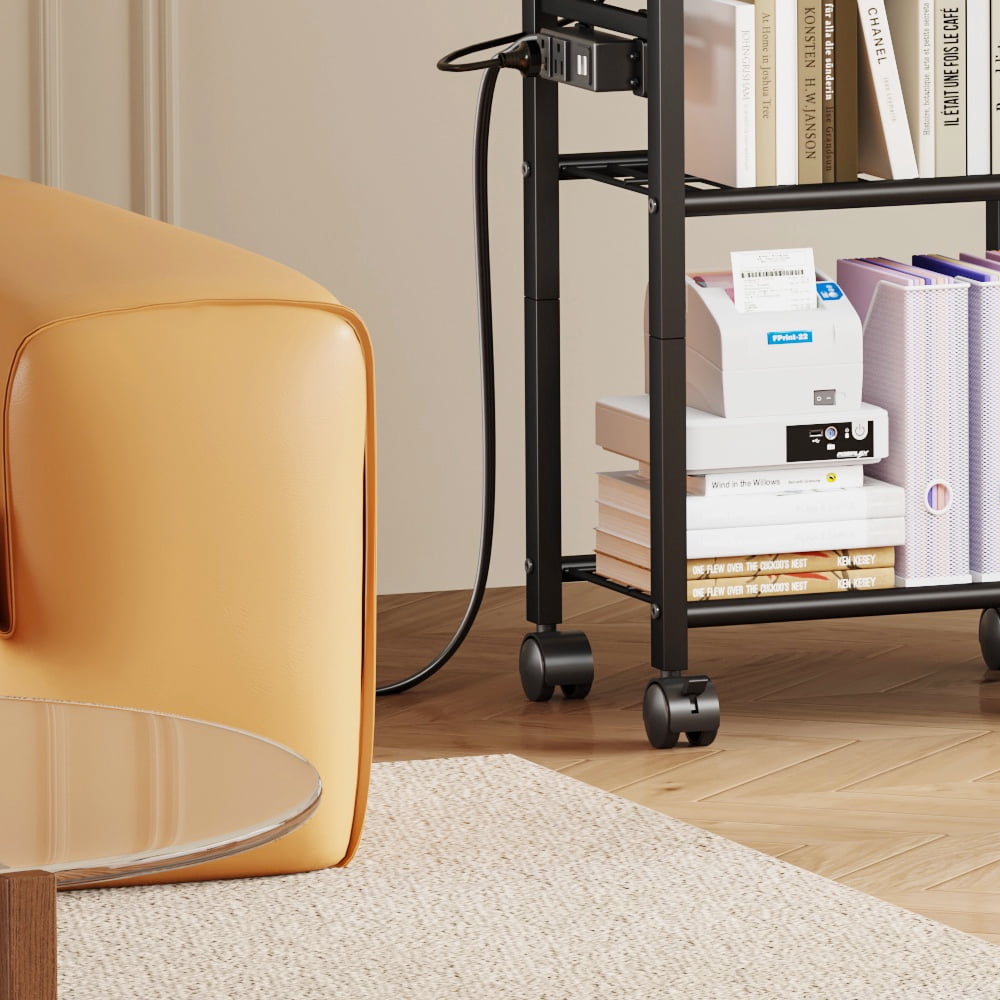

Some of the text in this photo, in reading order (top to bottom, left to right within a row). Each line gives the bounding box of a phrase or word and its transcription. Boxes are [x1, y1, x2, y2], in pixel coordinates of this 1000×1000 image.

[825, 20, 834, 38] alla
[868, 7, 887, 65] CHANEL
[804, 7, 816, 68] KONSTEN
[825, 40, 834, 55] die
[760, 12, 771, 119] At Home in Joshua Tree
[940, 7, 960, 127] IL ÉTAIT UNE FOIS LE CAFÉ
[712, 481, 730, 489] Wind
[853, 554, 876, 565] KESEY
[727, 563, 744, 573] OVER
[746, 562, 759, 571] THE
[853, 577, 876, 587] KESEY
[727, 586, 744, 596] OVER
[746, 584, 759, 594] THE
